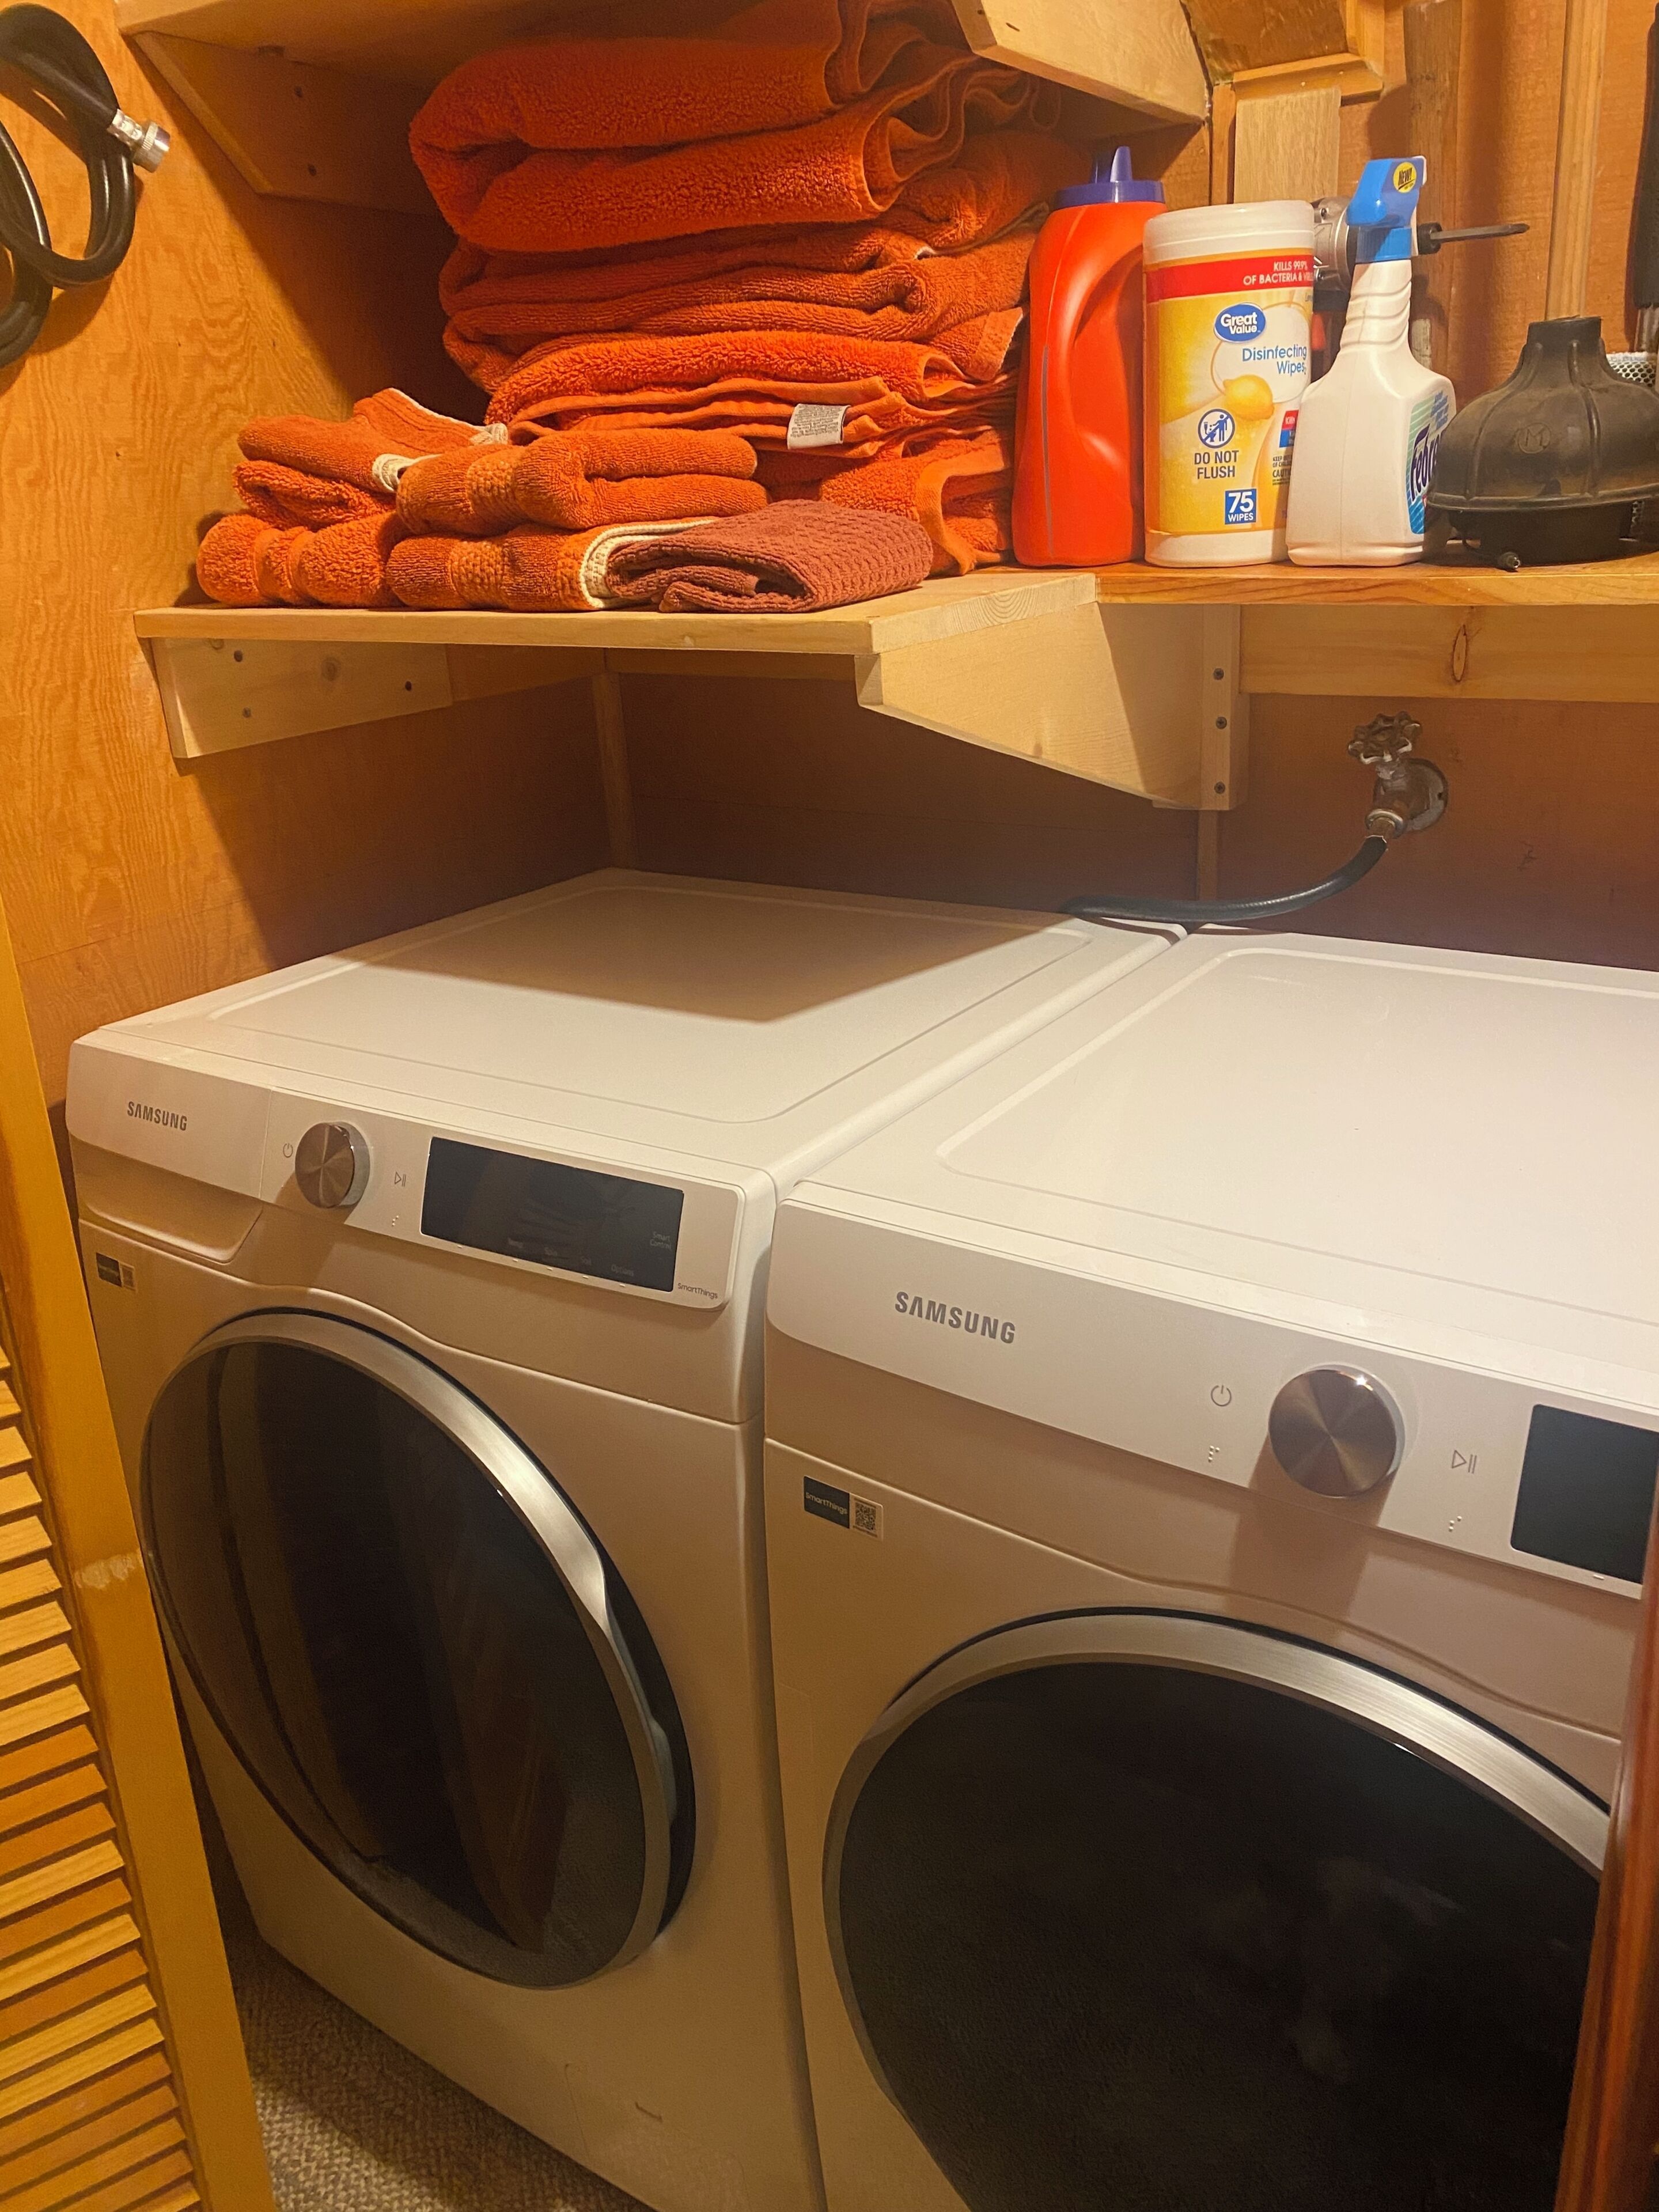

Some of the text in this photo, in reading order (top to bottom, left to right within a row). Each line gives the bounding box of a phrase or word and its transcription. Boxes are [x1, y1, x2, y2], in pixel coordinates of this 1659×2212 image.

[1274, 261, 1292, 271] KILLS
[1243, 275, 1257, 286] OF
[1259, 272, 1297, 284] BACTERIA
[1221, 312, 1257, 327] Great
[1229, 324, 1257, 334] Value
[1243, 344, 1307, 361] Disinfecting
[1277, 361, 1304, 376] Wipes
[1194, 450, 1239, 465] DO NOT
[1197, 465, 1235, 479] FLUSH
[1228, 491, 1254, 513] 75
[1228, 512, 1253, 522] WIPES
[127, 1101, 188, 1131] SAMSUNG
[677, 1282, 718, 1300] SmartThings
[895, 1291, 1016, 1344] SAMSUNG
[805, 1492, 849, 1515] SmartThings
